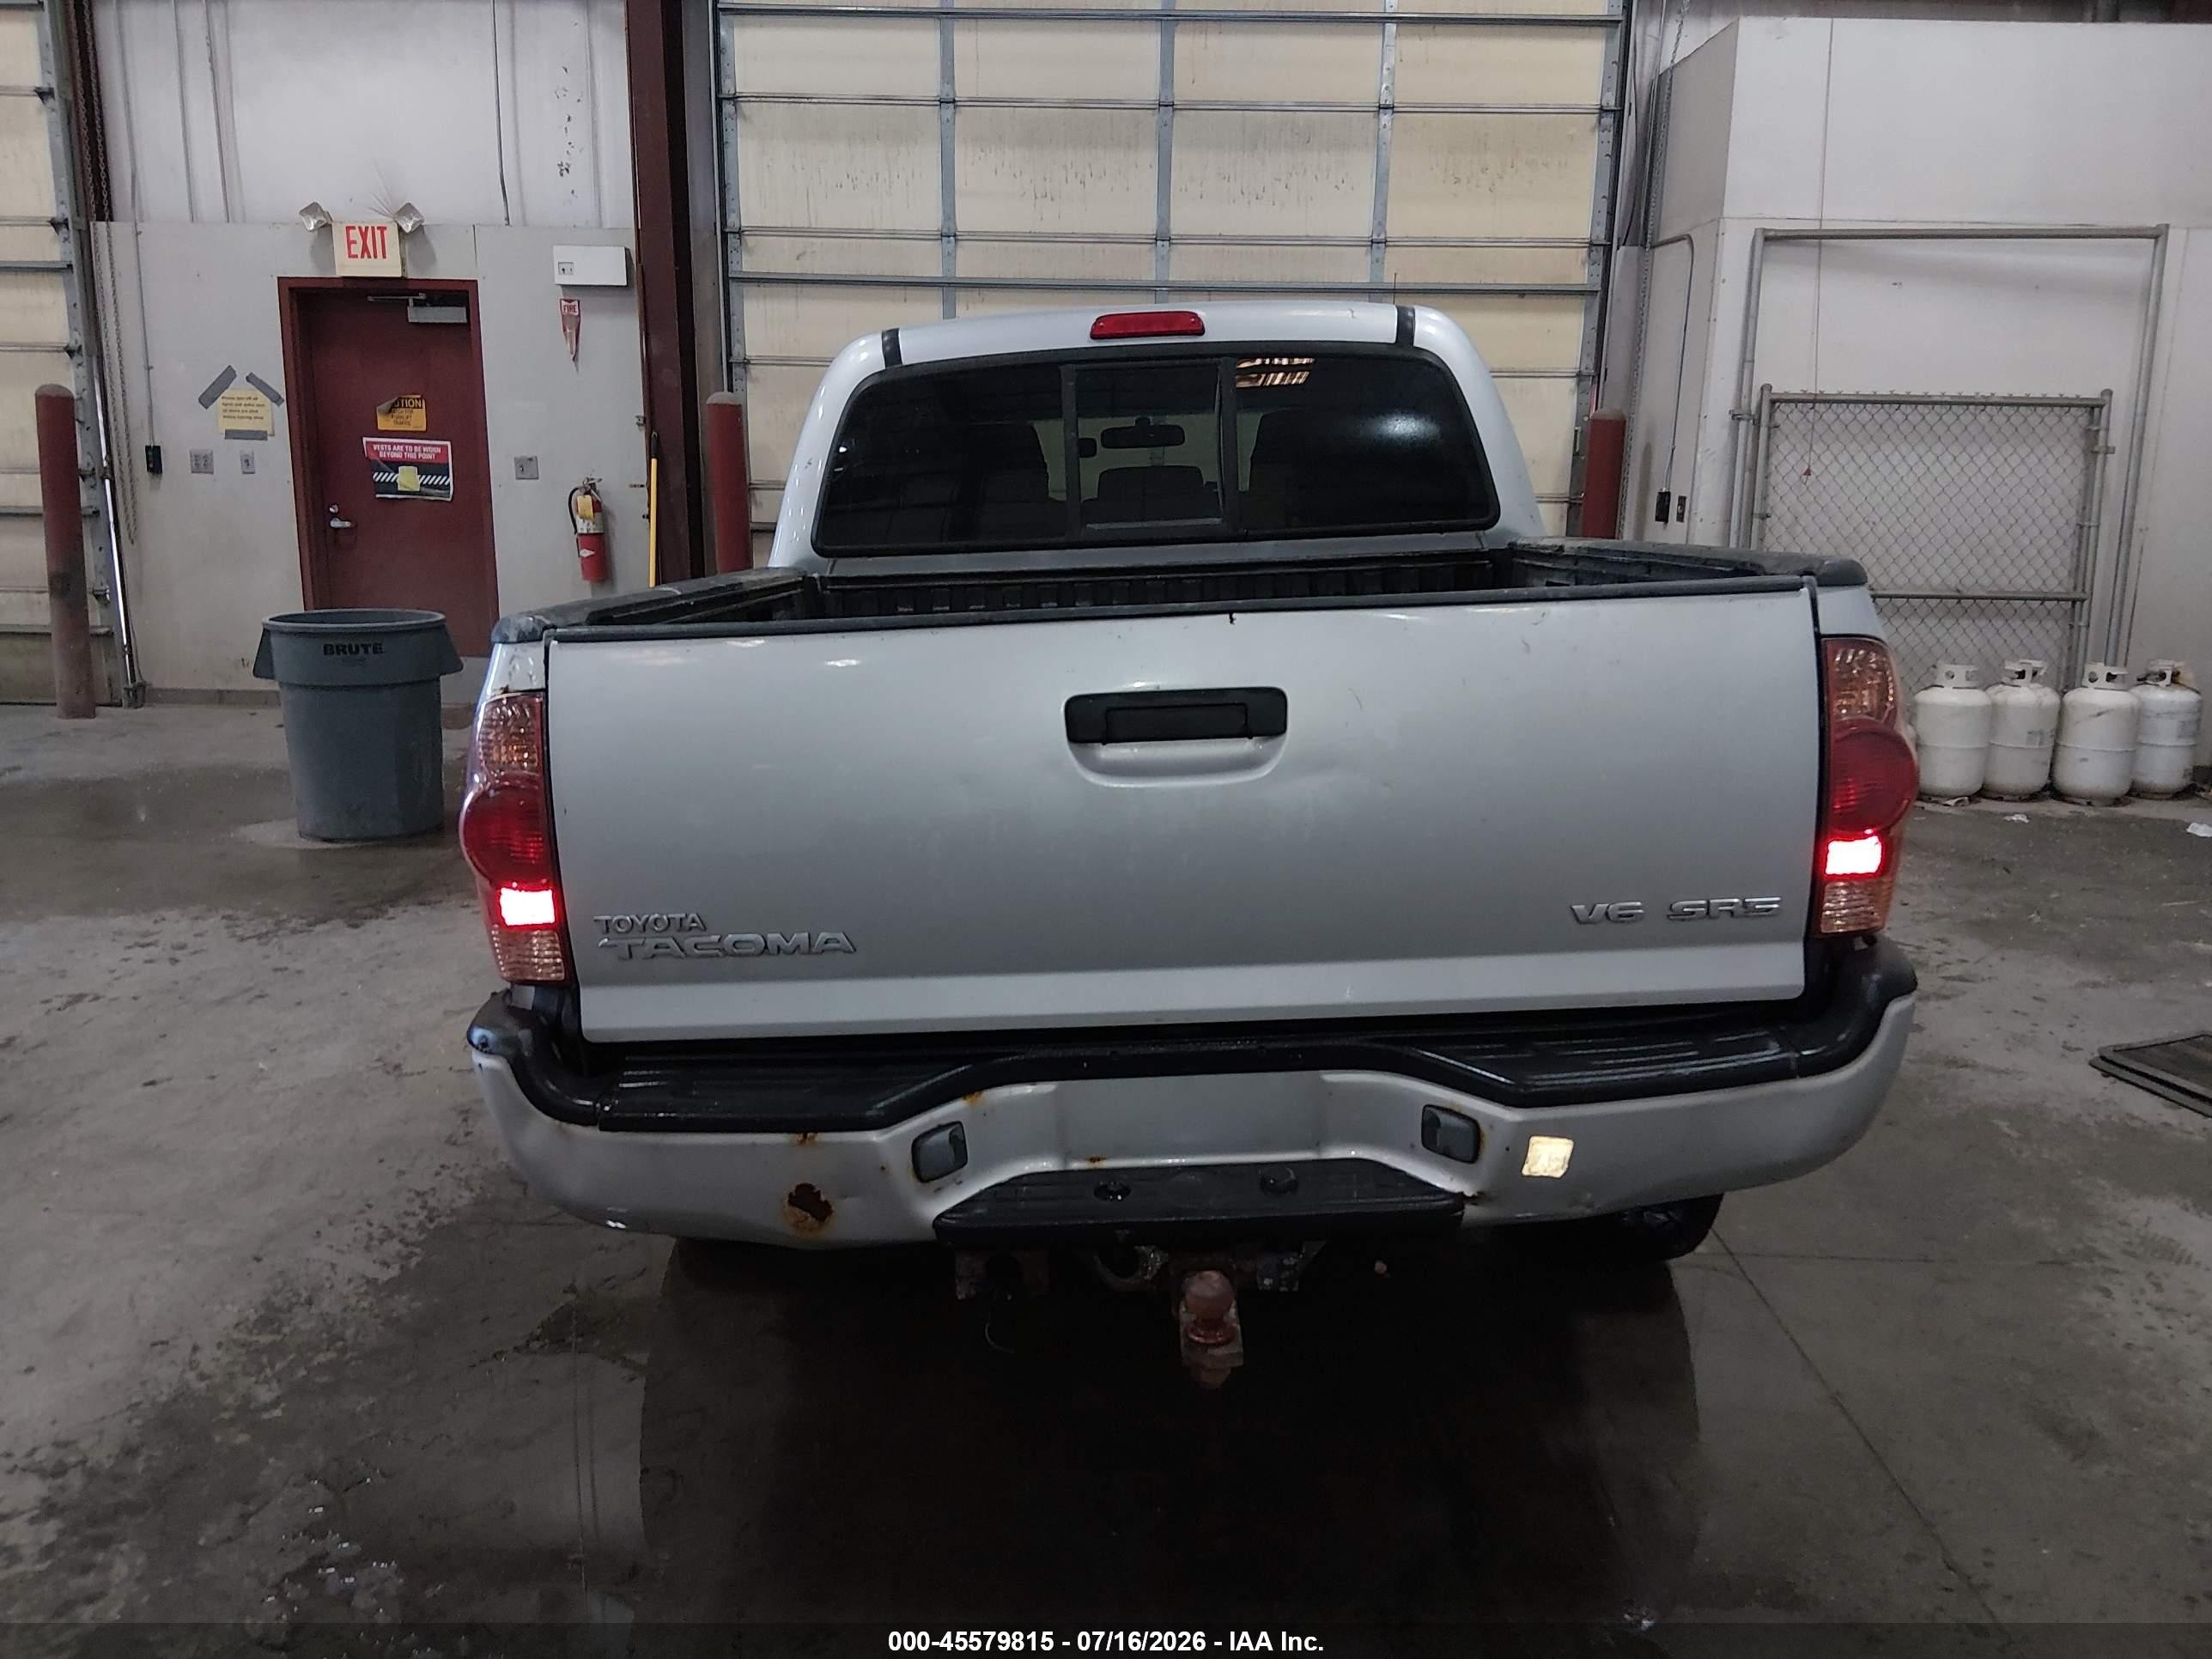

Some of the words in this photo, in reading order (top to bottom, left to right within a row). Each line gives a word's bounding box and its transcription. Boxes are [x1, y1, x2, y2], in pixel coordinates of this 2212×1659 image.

[345, 226, 387, 259] EXIT
[562, 304, 578, 313] FIRE
[323, 643, 384, 655] BRUTE
[1571, 901, 1644, 924] V6
[1668, 896, 1782, 921] SR5
[593, 913, 707, 933] TOYOTA
[598, 931, 857, 961] TACOMA
